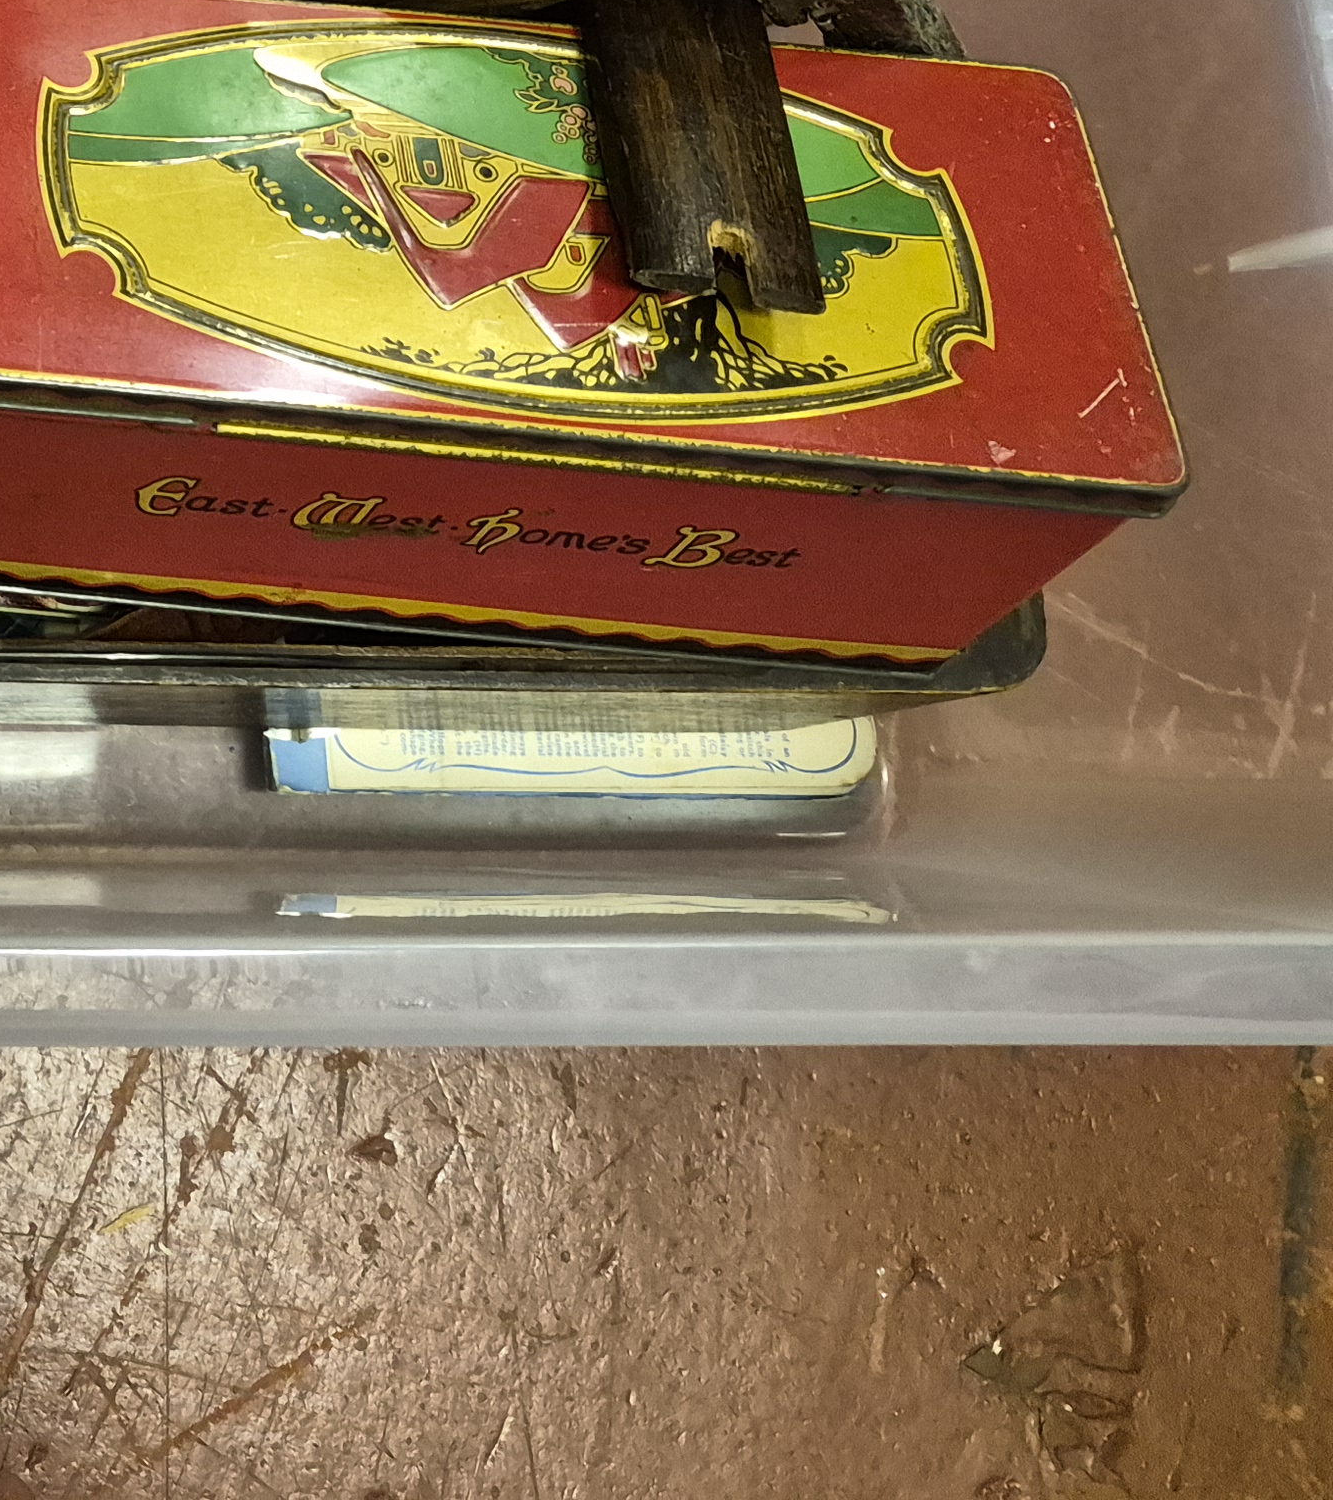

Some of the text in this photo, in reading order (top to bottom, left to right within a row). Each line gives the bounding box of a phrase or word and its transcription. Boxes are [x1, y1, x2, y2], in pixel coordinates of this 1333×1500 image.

[134, 475, 275, 518] East
[459, 507, 652, 555] Home's
[639, 525, 802, 569] Best
